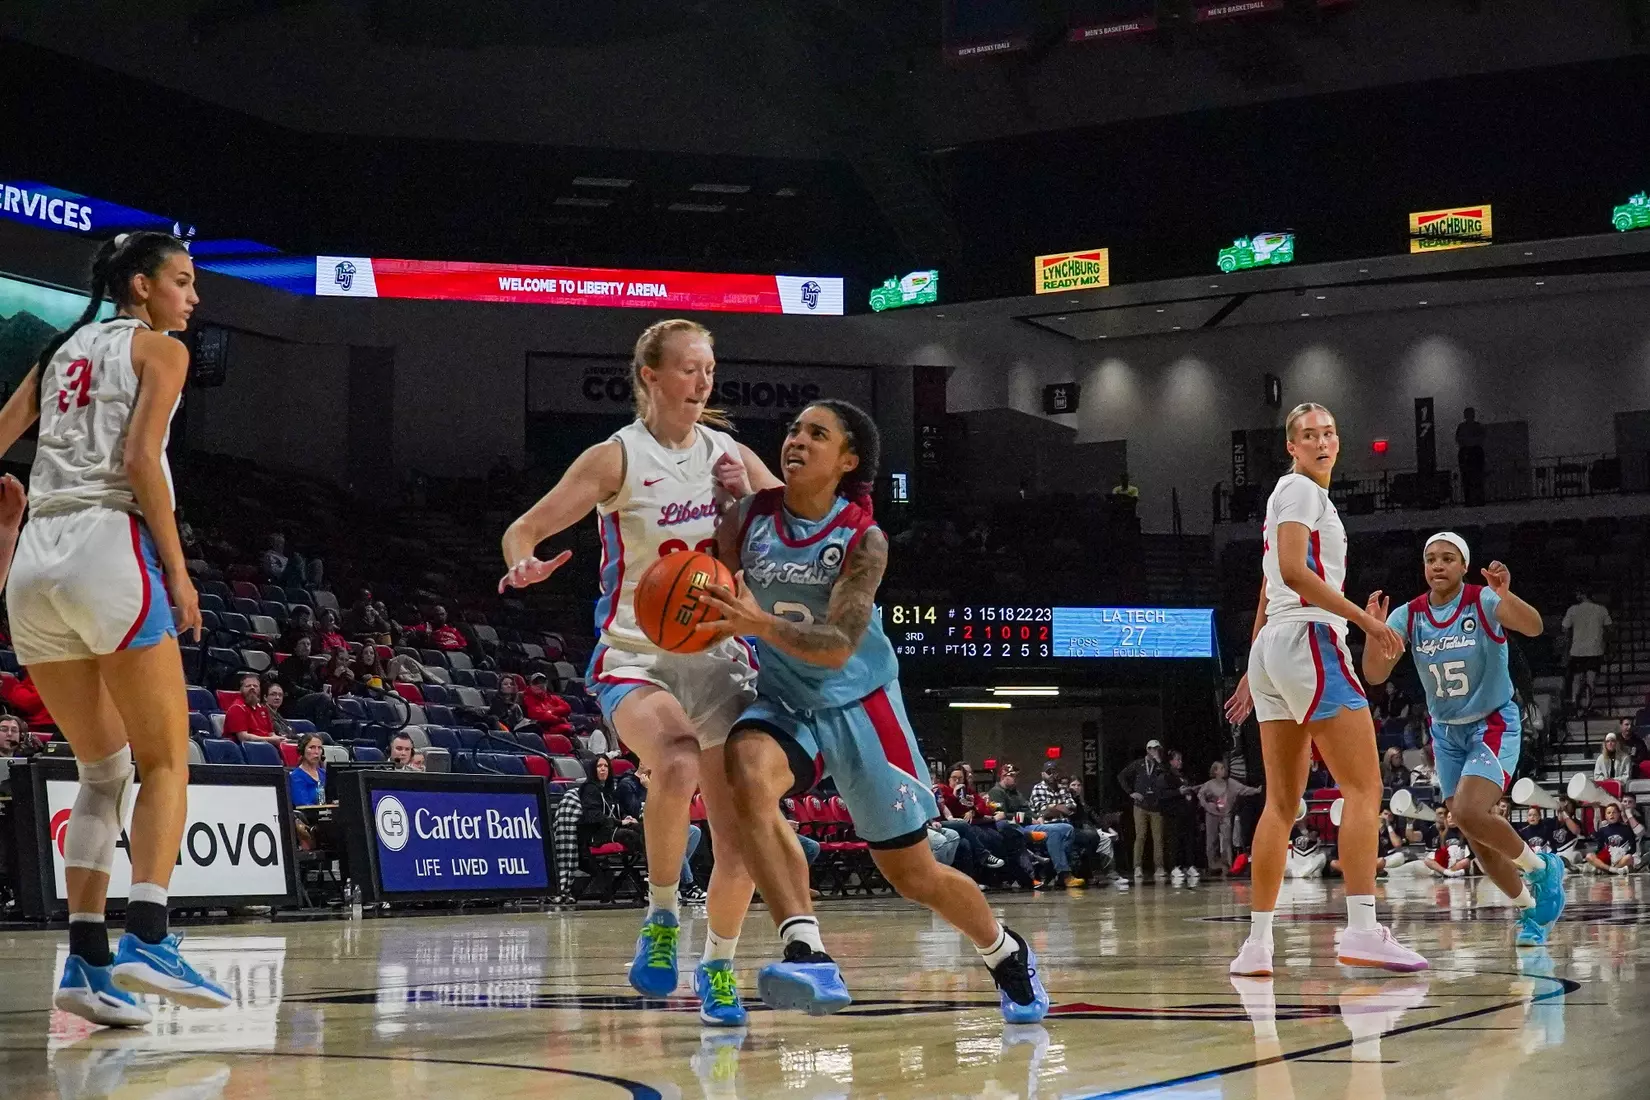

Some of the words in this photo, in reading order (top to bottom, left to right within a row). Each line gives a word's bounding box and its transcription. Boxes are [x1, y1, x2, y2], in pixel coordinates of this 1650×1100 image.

[1207, 7, 1227, 16] MEN'S
[1227, 1, 1265, 13] BASKETBALL
[1085, 28, 1103, 37] MEN'S
[1104, 22, 1140, 35] BASKETBALL
[0, 184, 92, 231] RVICES
[1417, 217, 1483, 236] LYNCHBURG
[1043, 260, 1100, 280] LYNCHBURG
[498, 276, 557, 293] WELCOME
[559, 280, 576, 295] TO
[577, 281, 624, 296] LIBERTY
[626, 283, 668, 298] ARENA
[1043, 278, 1080, 290] READY
[1080, 275, 1101, 286] MIX
[1420, 406, 1432, 437] 17
[1234, 444, 1246, 487] OMEN
[892, 605, 937, 624] 8:14
[964, 607, 973, 620] 3
[980, 607, 996, 620] 15
[999, 607, 1015, 621] 18
[1016, 607, 1034, 621] 22
[1035, 608, 1052, 621] 23
[1102, 609, 1123, 623] LA
[1125, 609, 1166, 623] TECH
[905, 632, 924, 641] 3RD
[949, 627, 956, 637] F
[964, 625, 973, 639] 2
[985, 626, 992, 639] 1
[1001, 626, 1011, 640] 0
[1021, 626, 1030, 640] 0
[1040, 626, 1048, 640] 2
[1121, 625, 1148, 647] 27
[905, 646, 916, 655] 30
[922, 646, 929, 655] F
[931, 646, 936, 655] 1
[961, 643, 977, 656] 13
[983, 643, 992, 656] 2
[1002, 643, 1011, 656] 2
[1021, 643, 1030, 657] 5
[1040, 644, 1048, 657] 3
[1428, 660, 1470, 698] 15
[1084, 739, 1098, 777] MEN
[414, 807, 482, 840] Carter
[486, 806, 542, 840] Bank
[415, 859, 443, 877] LIFE
[451, 858, 489, 876] LIVED
[498, 857, 530, 875] FULL
